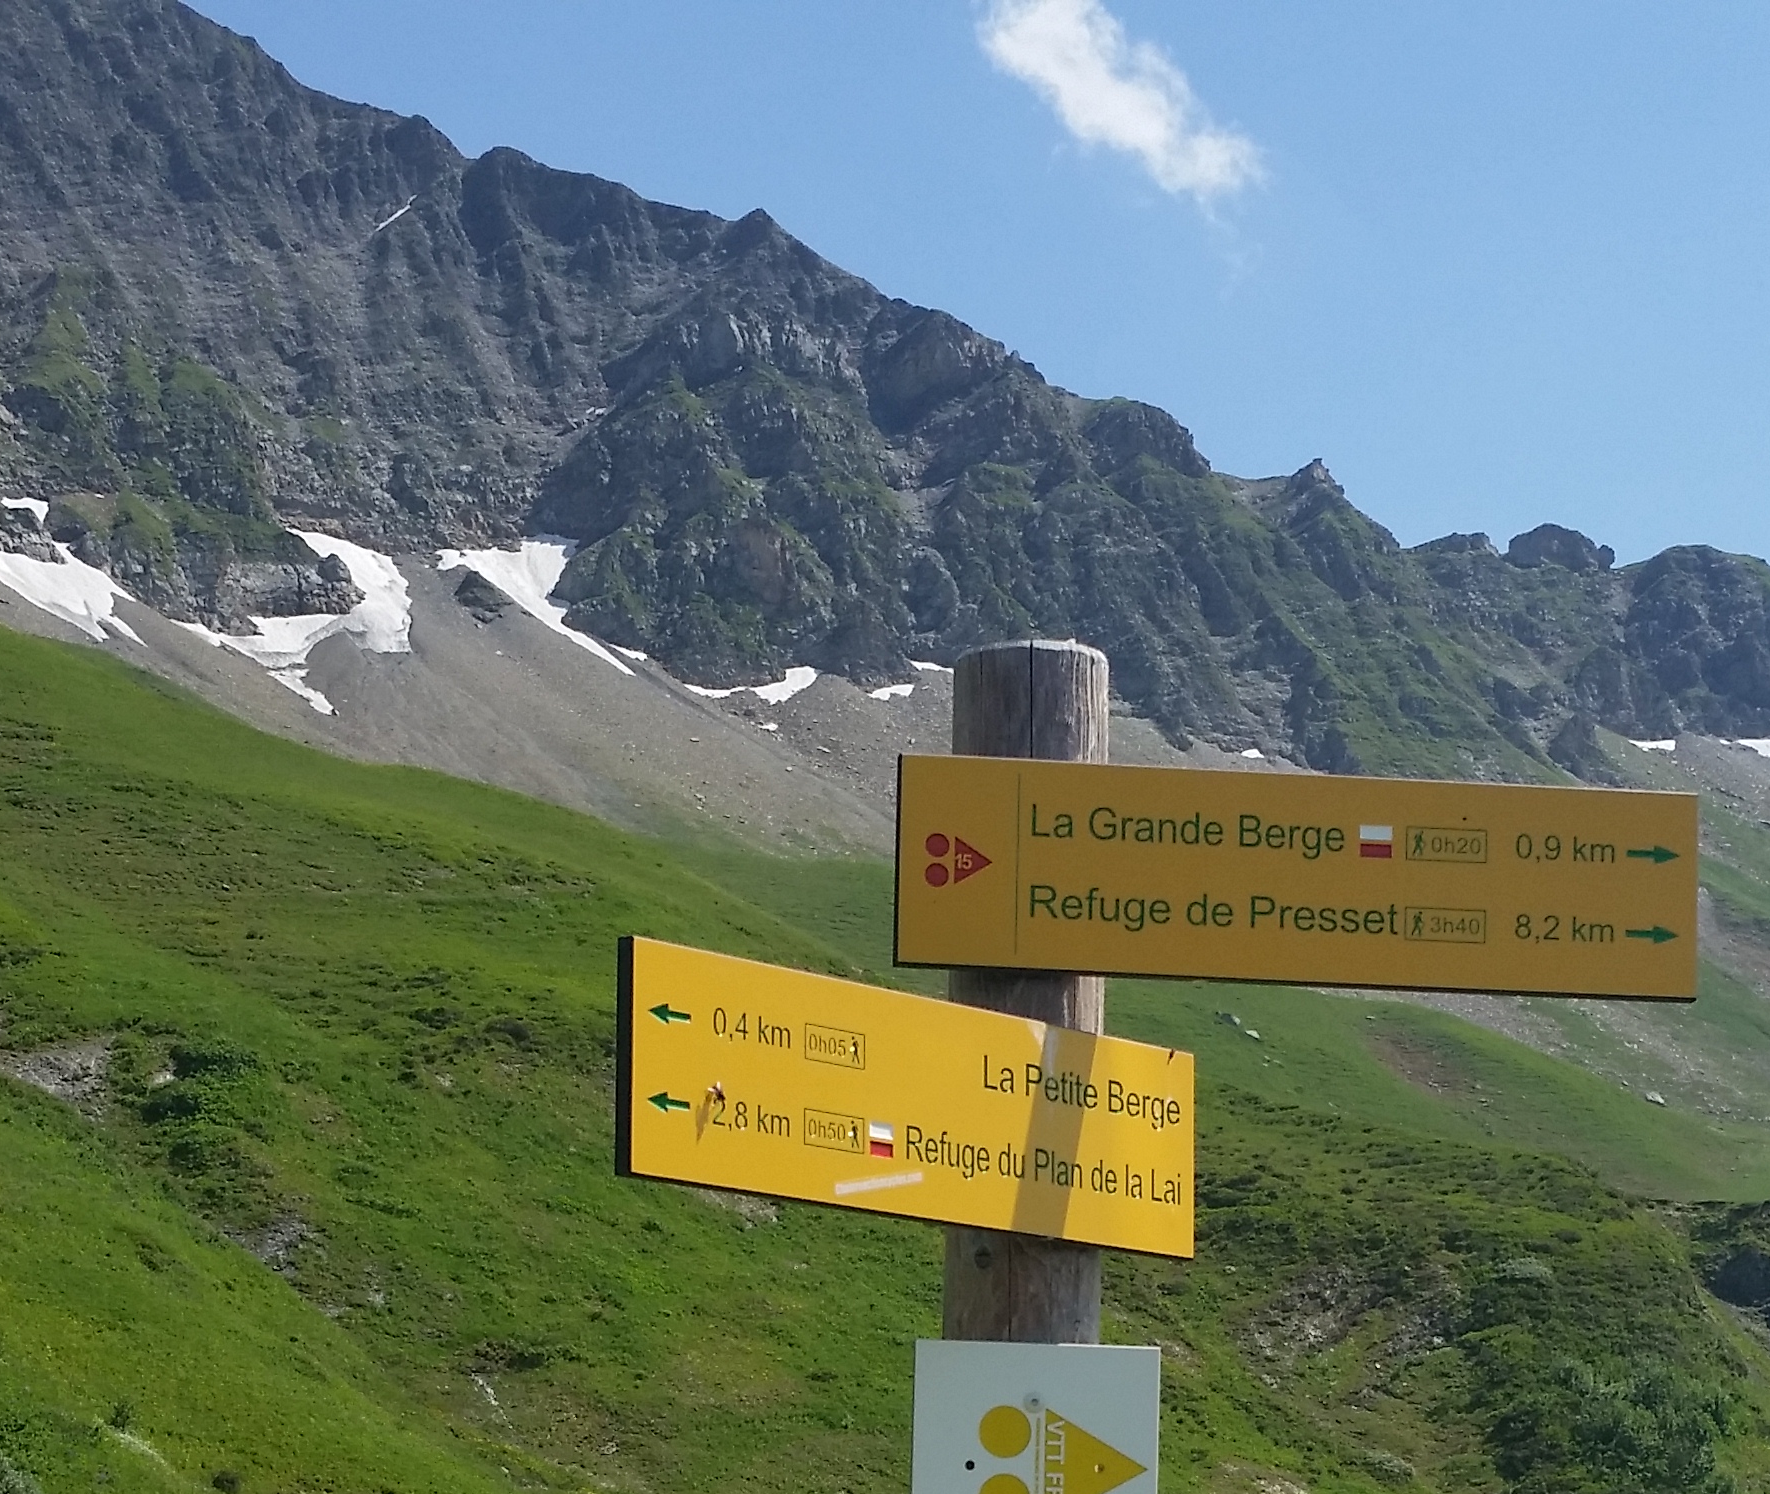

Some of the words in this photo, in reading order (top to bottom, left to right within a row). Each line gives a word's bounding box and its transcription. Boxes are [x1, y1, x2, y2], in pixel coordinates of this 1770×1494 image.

[954, 852, 973, 870] 15
[1030, 803, 1074, 839] La
[1088, 806, 1224, 846] Grande
[1238, 814, 1345, 860] Berge
[1431, 835, 1481, 855] 0h20
[1515, 833, 1562, 863] 0,9
[1573, 837, 1615, 863] km
[1029, 884, 1171, 932] Refuge
[1187, 894, 1234, 928] de
[1249, 896, 1398, 936] Presset
[1430, 917, 1480, 936] 3h40
[1514, 913, 1560, 944] 8,2
[1572, 917, 1614, 943] km
[712, 1007, 749, 1042] 0,4
[758, 1016, 791, 1049] km
[808, 1033, 847, 1059] 0h05
[983, 1055, 1015, 1094] La
[1025, 1063, 1098, 1109] Petite
[1108, 1080, 1181, 1131] Berge
[712, 1097, 749, 1132] 2,8
[757, 1104, 791, 1138] km
[807, 1118, 847, 1142] 0h50
[905, 1125, 990, 1180] Refuge
[998, 1143, 1026, 1180] du
[1034, 1148, 1083, 1189] Plan
[1090, 1160, 1118, 1194] de
[1125, 1164, 1143, 1200] la
[1151, 1168, 1181, 1206] Lai
[1045, 1420, 1065, 1465] VTT
